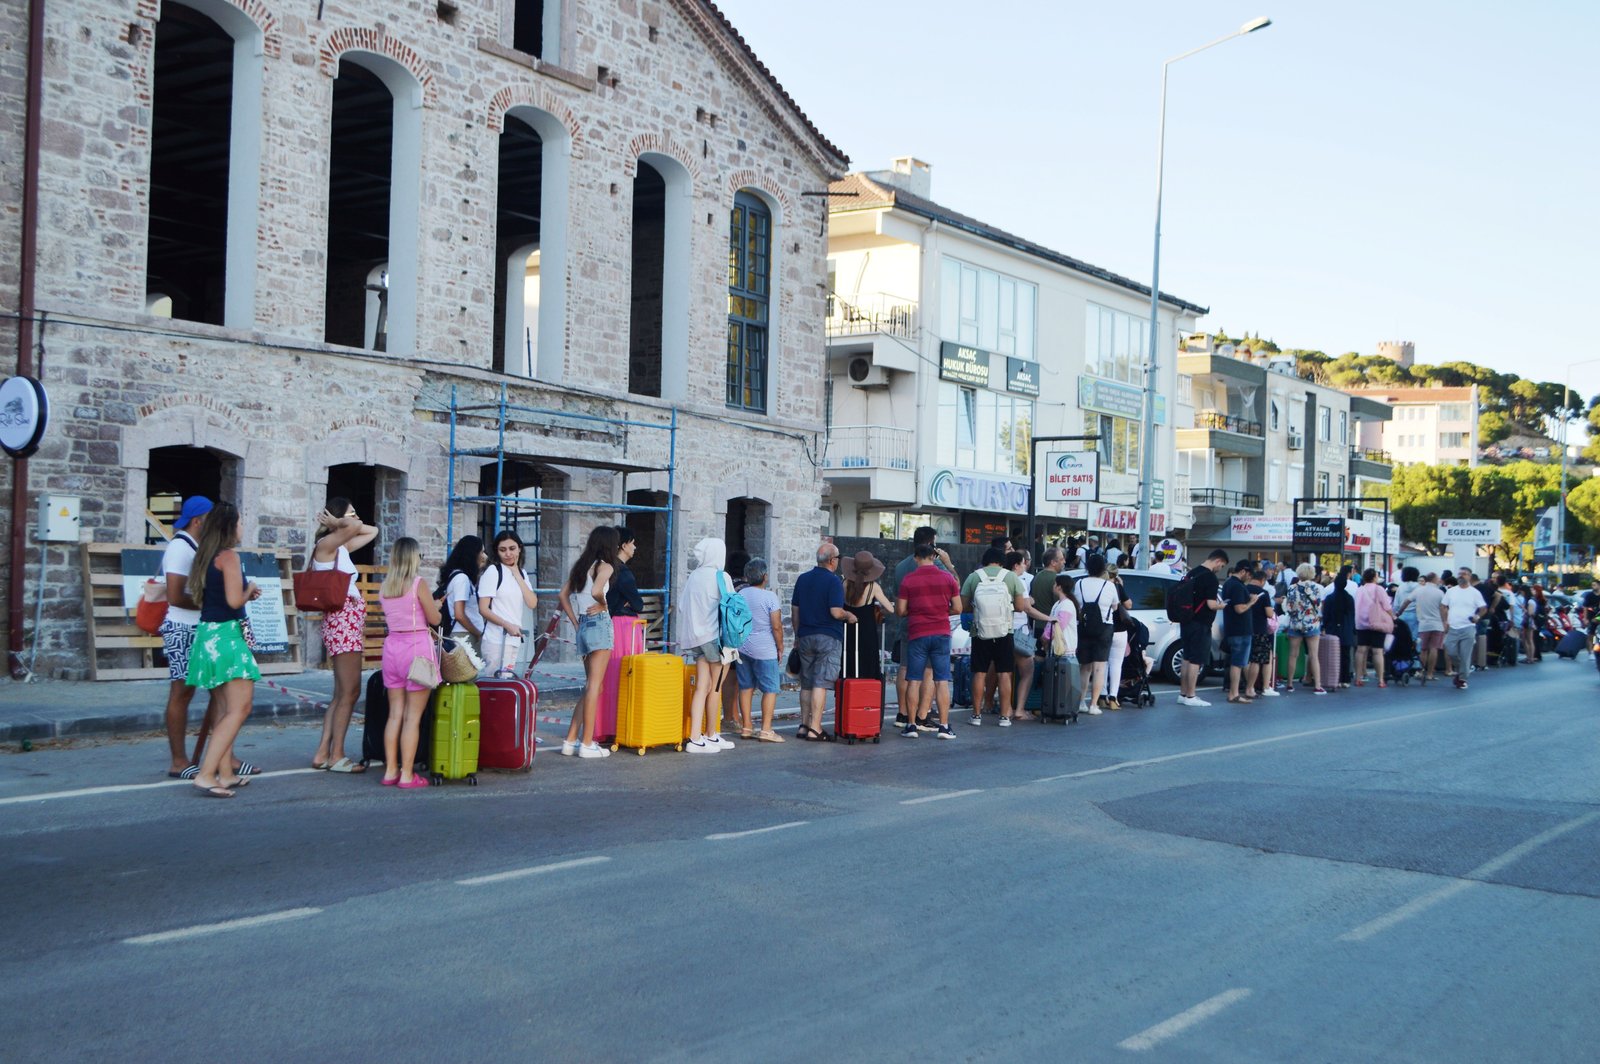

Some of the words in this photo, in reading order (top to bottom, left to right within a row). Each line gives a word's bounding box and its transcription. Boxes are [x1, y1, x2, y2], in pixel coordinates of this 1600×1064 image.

[957, 347, 977, 363] AKSAÇ
[943, 358, 965, 372] HUKUK
[965, 361, 988, 377] BÜROSU
[1016, 372, 1031, 383] AKSAÇ
[1049, 473, 1071, 483] BİLET
[1072, 474, 1094, 484] SATIŞ
[1061, 486, 1081, 496] OFİSİ
